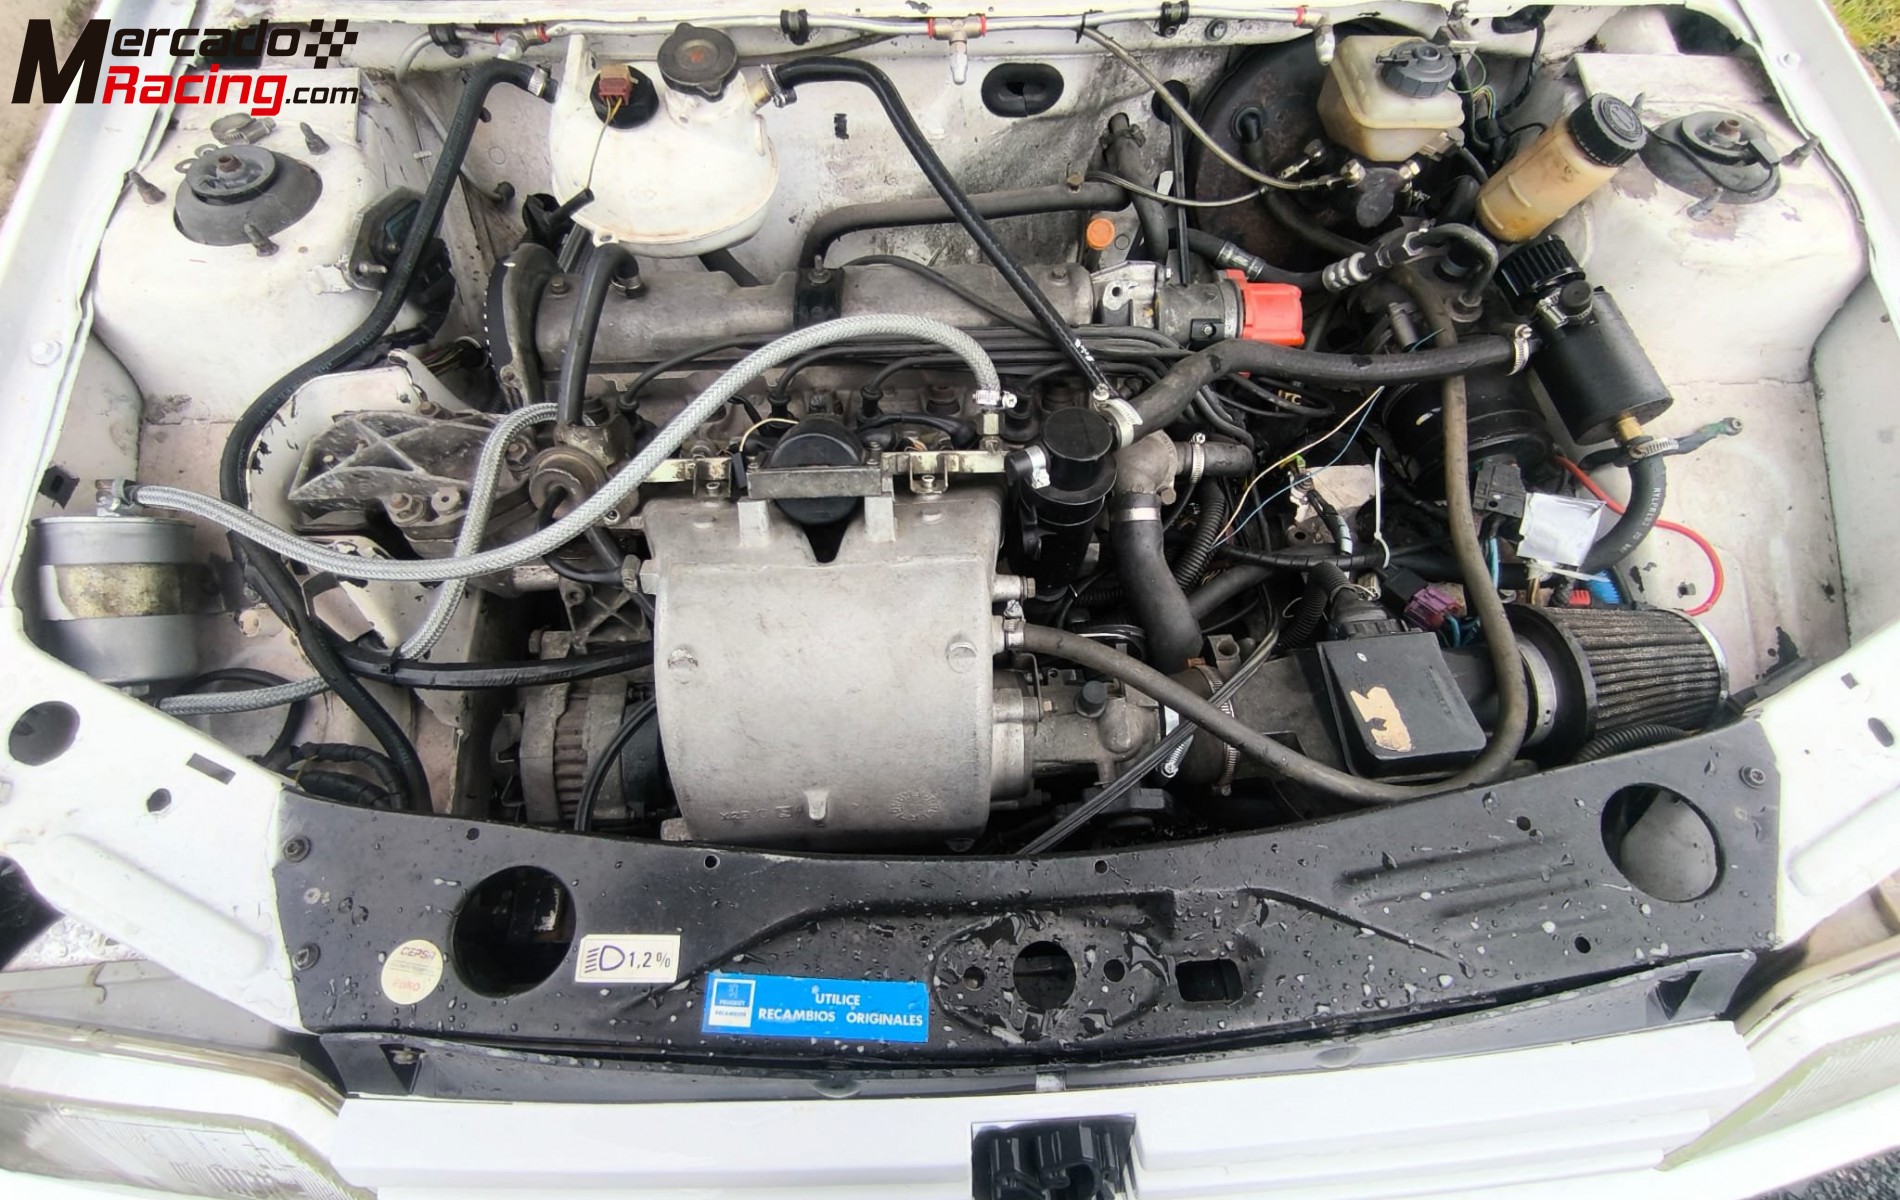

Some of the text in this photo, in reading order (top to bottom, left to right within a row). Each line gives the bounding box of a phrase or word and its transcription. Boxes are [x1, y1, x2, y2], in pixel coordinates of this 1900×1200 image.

[400, 946, 436, 960] CEPSA
[815, 992, 861, 1006] UTILICE
[758, 1008, 924, 1026] RECAMBIOS ORIGINALES
